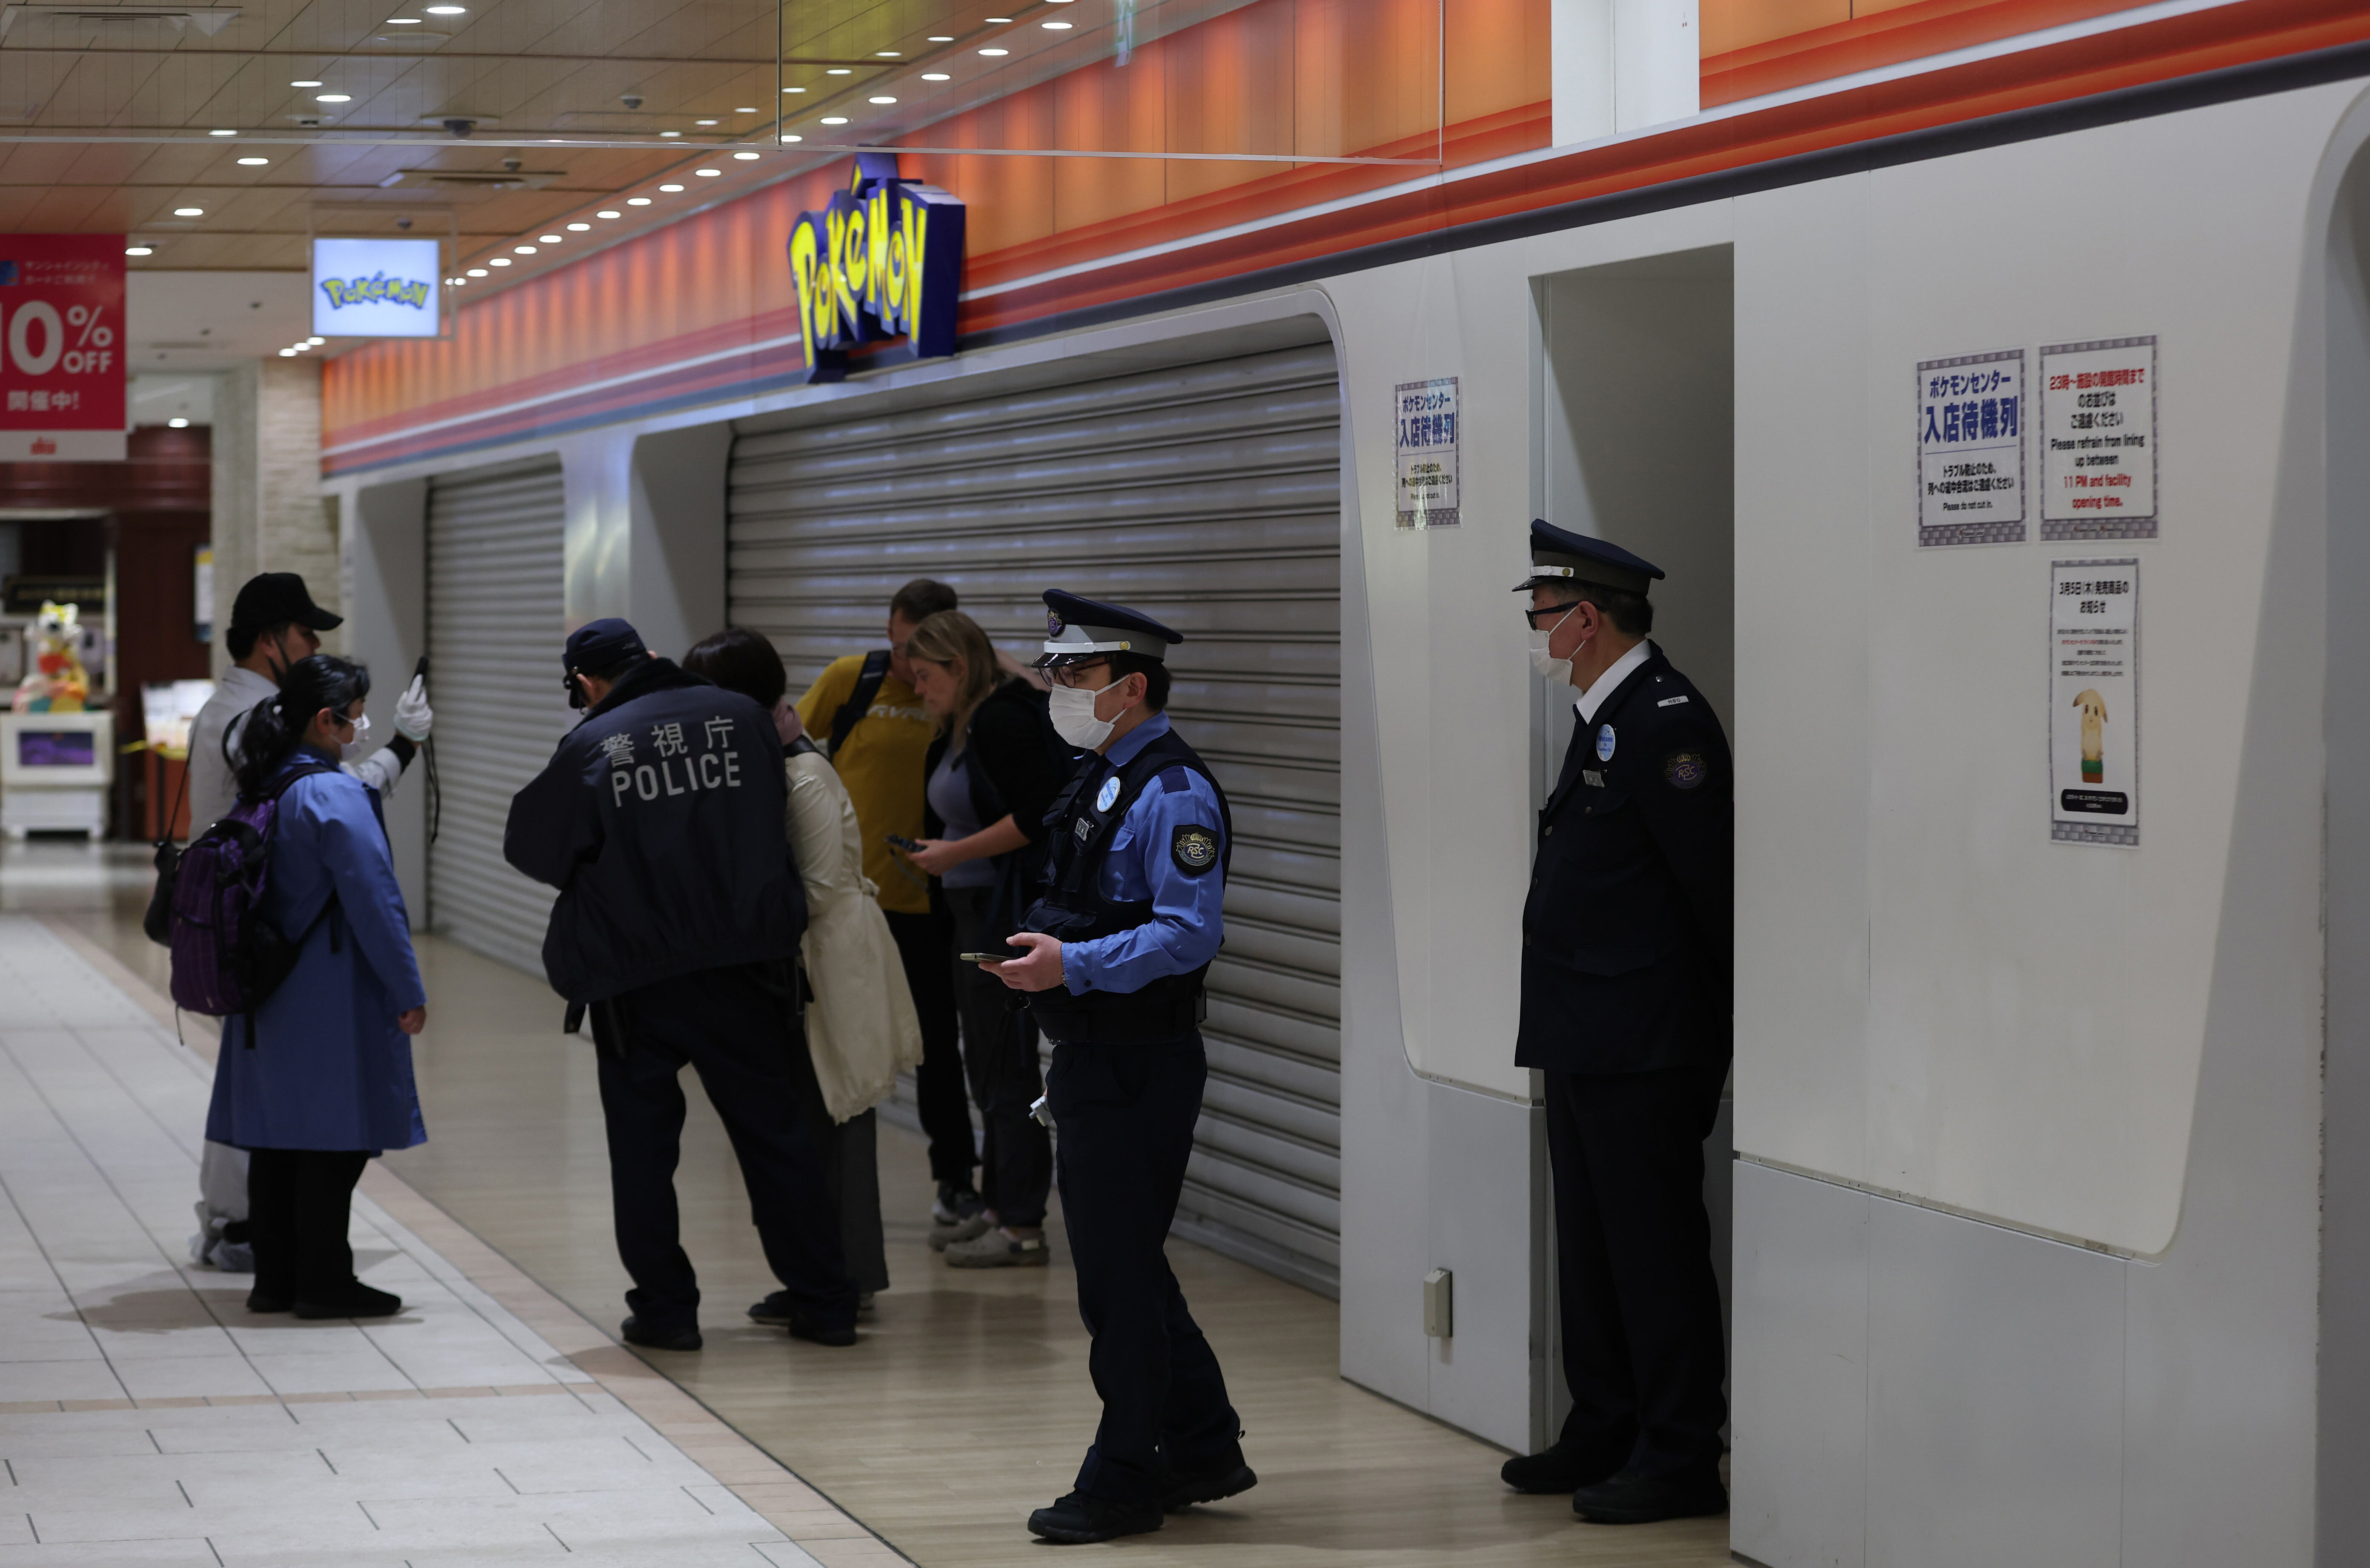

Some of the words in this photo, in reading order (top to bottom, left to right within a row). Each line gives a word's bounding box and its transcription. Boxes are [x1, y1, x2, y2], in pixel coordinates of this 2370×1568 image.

[62, 350, 113, 375] OFF
[1929, 369, 2011, 399] ポケモンセンター
[1403, 392, 1451, 413] ポケモンセンター
[1924, 395, 2018, 444] 入店待機列
[1400, 412, 1454, 448] 入店待機列
[2051, 438, 2075, 451] Please
[2077, 436, 2103, 449] refrain
[2104, 435, 2122, 447] from
[2123, 433, 2145, 447] lining
[2075, 457, 2084, 468] up
[2086, 454, 2119, 466] between
[2064, 476, 2073, 488] 11
[2075, 475, 2088, 488] PM
[2089, 475, 2104, 487] and
[2105, 473, 2132, 487] facility
[1943, 502, 1960, 511] Please
[1961, 501, 1967, 510] do
[1968, 501, 1976, 509] not
[1977, 501, 1986, 509] cut
[2072, 496, 2102, 510] opening
[2104, 495, 2123, 508] time.
[2080, 600, 2106, 614] お知らせ
[600, 715, 734, 768] 警視庁
[611, 752, 741, 808] POLICE
[1106, 781, 1114, 801] Welcome
[1186, 844, 1205, 858] RSC
